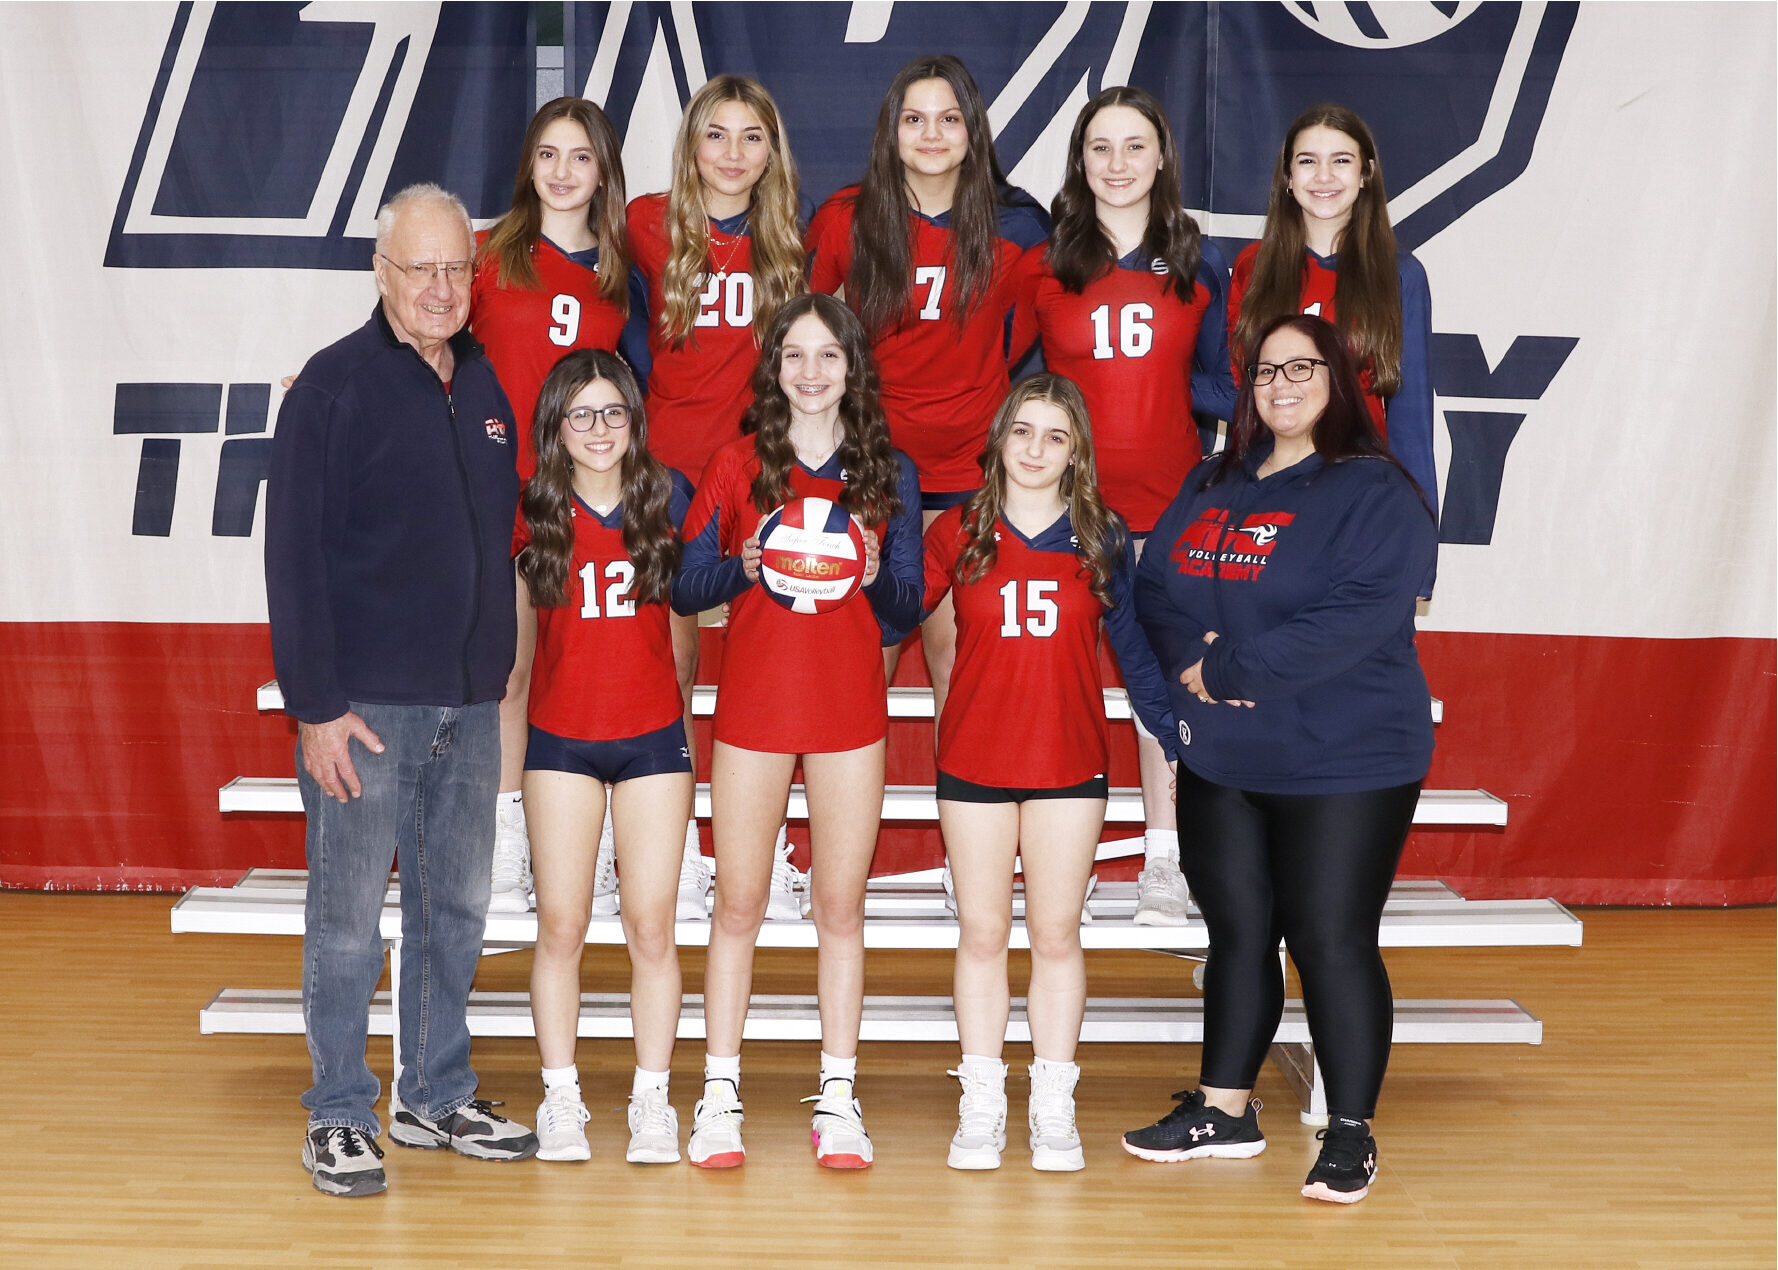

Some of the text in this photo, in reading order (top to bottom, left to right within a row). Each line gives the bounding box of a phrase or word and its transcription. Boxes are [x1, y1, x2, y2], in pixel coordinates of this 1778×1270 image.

[548, 293, 581, 347] 9
[693, 271, 754, 327] 20
[915, 265, 947, 321] 7
[1090, 302, 1154, 360] 16
[578, 560, 636, 619] 12
[776, 555, 841, 575] molten
[999, 579, 1059, 638] 15
